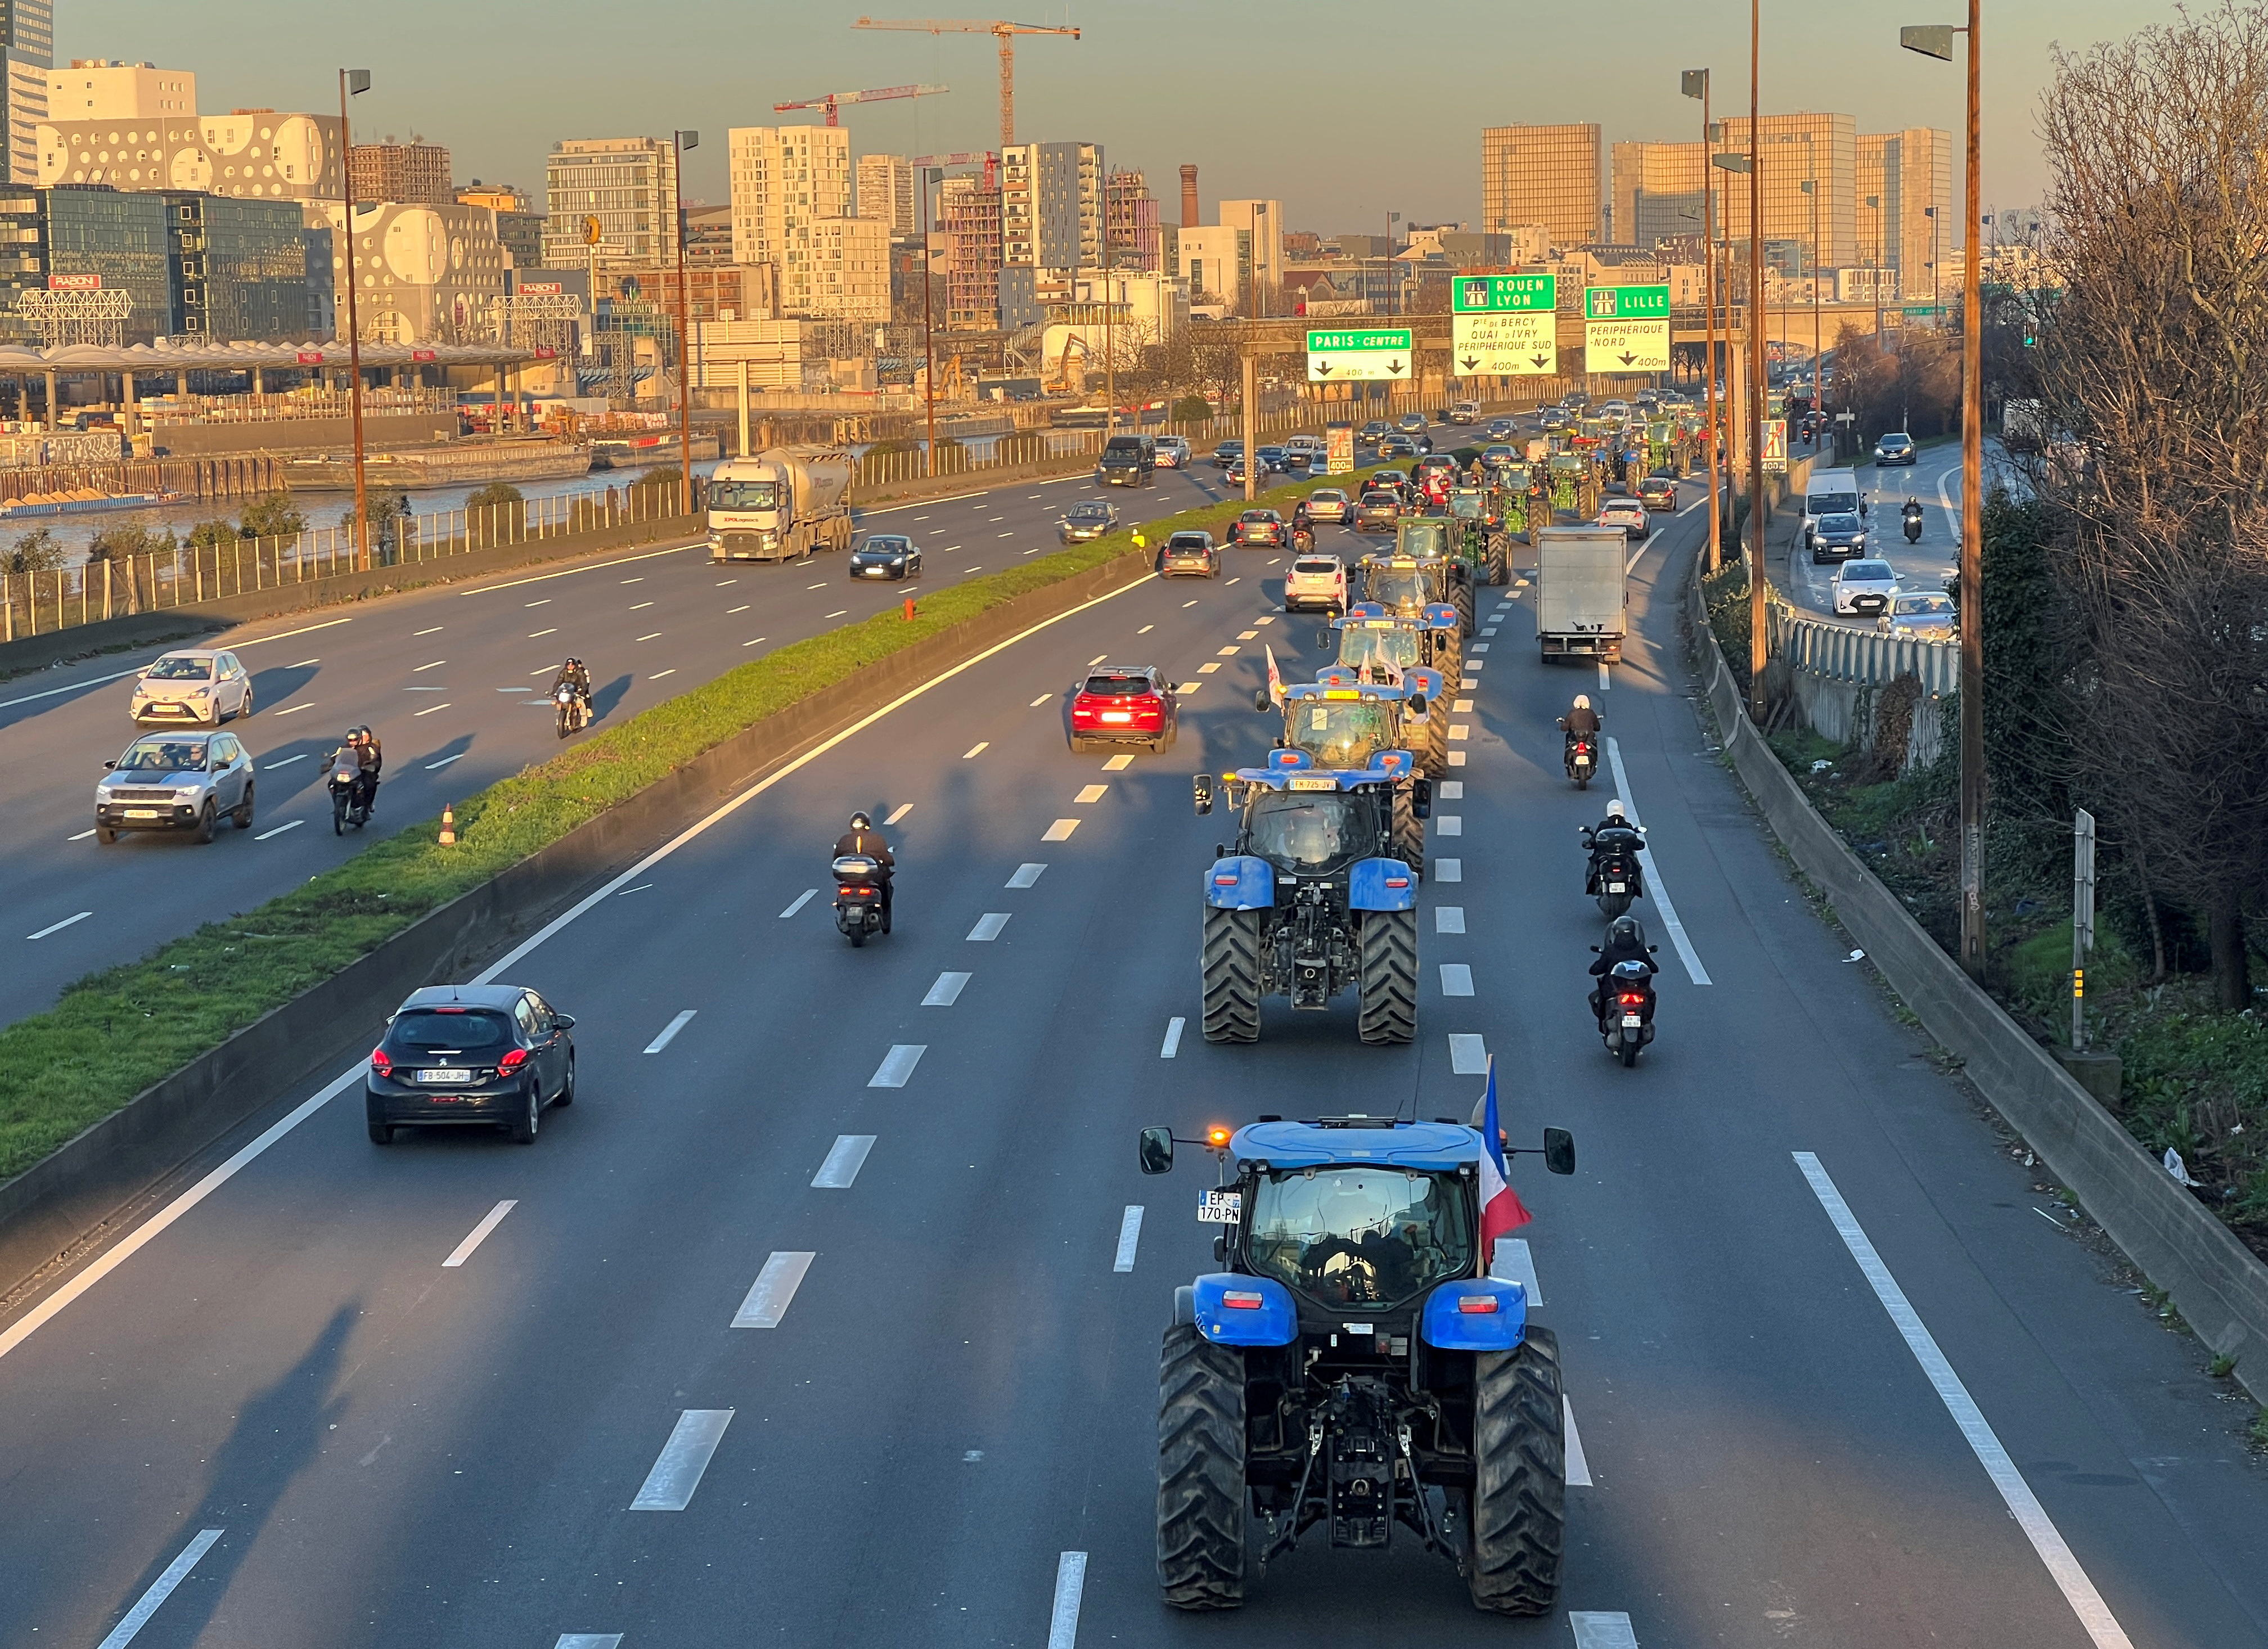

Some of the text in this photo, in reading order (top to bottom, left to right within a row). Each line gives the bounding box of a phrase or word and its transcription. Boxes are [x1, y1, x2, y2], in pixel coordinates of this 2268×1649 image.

[55, 277, 94, 286] RABONI
[1497, 280, 1544, 291] ROUEN
[1497, 294, 1531, 307] LYON
[1625, 295, 1664, 308] LILLE
[1501, 318, 1536, 327] BERCY
[1471, 330, 1498, 339] QUAI
[1590, 324, 1663, 335] PÉRIPHÉRIQUE
[1316, 335, 1354, 348] PARIS
[1363, 336, 1405, 346] CENTRE
[1458, 340, 1551, 351] PÉRIPHÉRIQUE SUD
[1491, 362, 1519, 371] 400m
[1637, 358, 1666, 366] 400m
